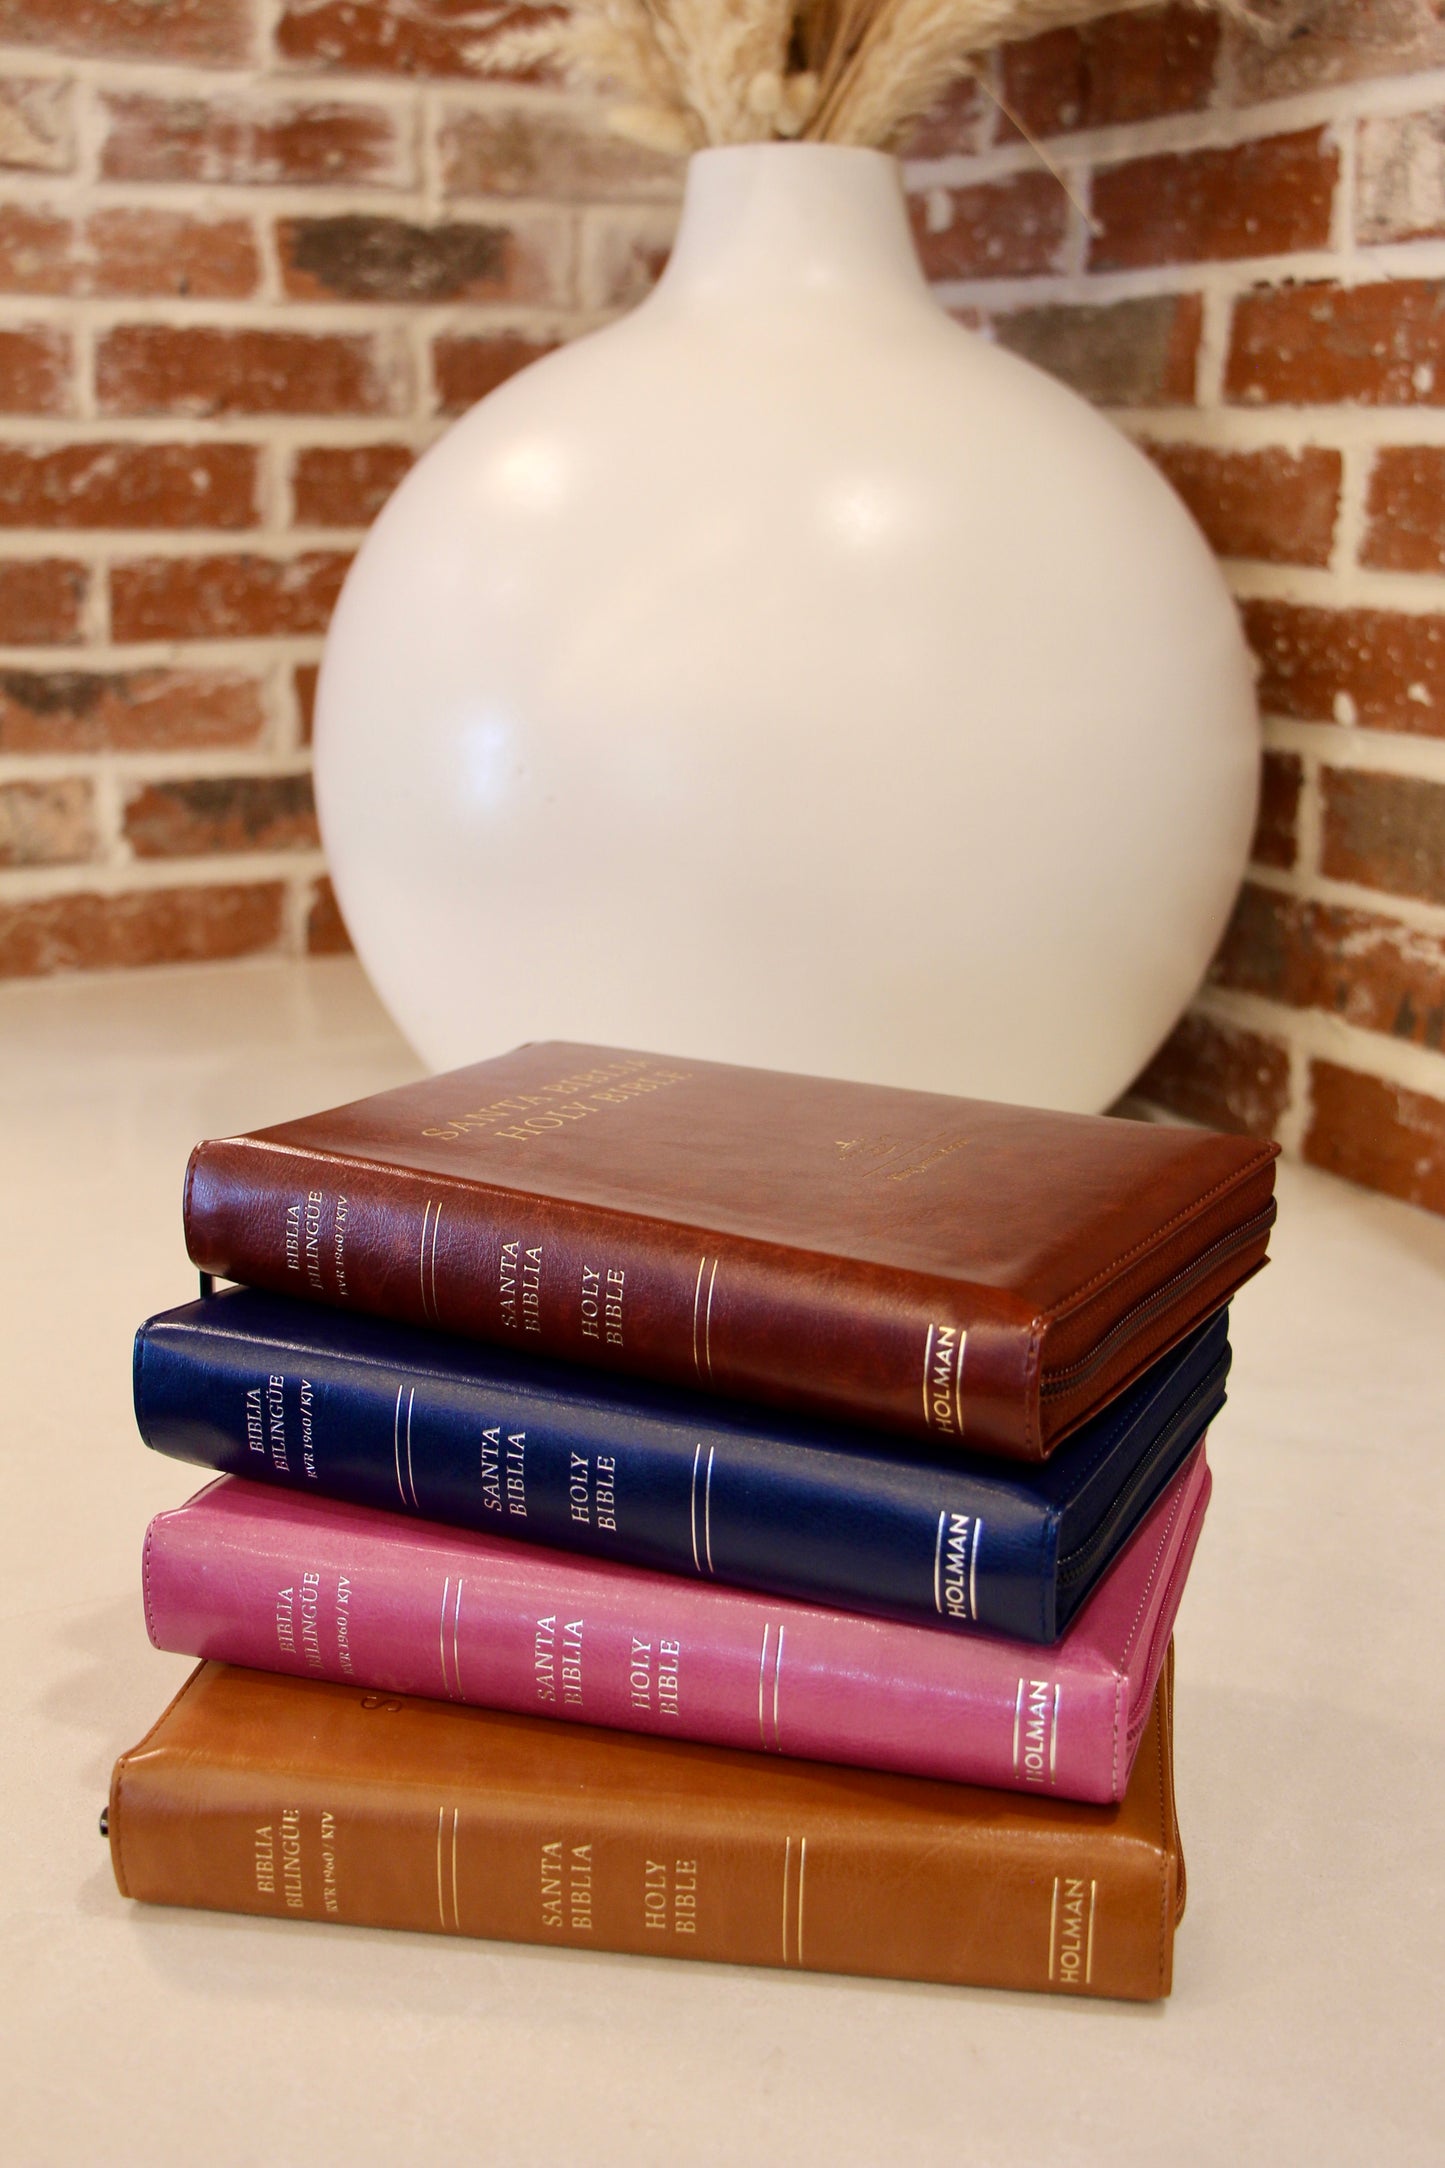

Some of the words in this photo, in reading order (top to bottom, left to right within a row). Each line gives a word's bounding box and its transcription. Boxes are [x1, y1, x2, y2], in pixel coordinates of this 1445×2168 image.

[421, 1093, 555, 1141] SANTA
[494, 1101, 600, 1142] HOLY
[590, 1070, 694, 1104] BIBLE
[285, 1204, 301, 1270] BIBLIA
[500, 1241, 520, 1329] SANTA
[522, 1246, 543, 1334] BIBLIA
[581, 1265, 600, 1339] HOLY
[605, 1269, 625, 1347] BIBLE
[933, 1326, 956, 1433] HOLMAN
[247, 1388, 265, 1454] BIBLIA
[266, 1374, 290, 1472] BILINGÜE
[302, 1417, 313, 1449] 1960
[481, 1426, 503, 1513] SANTA
[507, 1432, 528, 1517] BIBLIA
[570, 1452, 590, 1524] HOLY
[596, 1456, 617, 1531] BIBLE
[945, 1513, 971, 1618] HOLMAN
[276, 1587, 297, 1654] BIBLIA
[336, 1616, 350, 1650] 1960
[535, 1615, 557, 1702] SANTA
[562, 1619, 584, 1706] BIBLIA
[630, 1637, 651, 1710] HOLY
[658, 1640, 681, 1716] BIBLE
[1024, 1680, 1049, 1782] HOLMAN
[254, 1825, 275, 1893] BIBLIA
[279, 1808, 304, 1908] BILINGÜE
[541, 1841, 563, 1928] SANTA
[571, 1844, 592, 1929] BIBLIA
[645, 1860, 666, 1929] HOLY
[675, 1860, 697, 1933] BIBLE
[1060, 1878, 1084, 1983] HOLMAN
